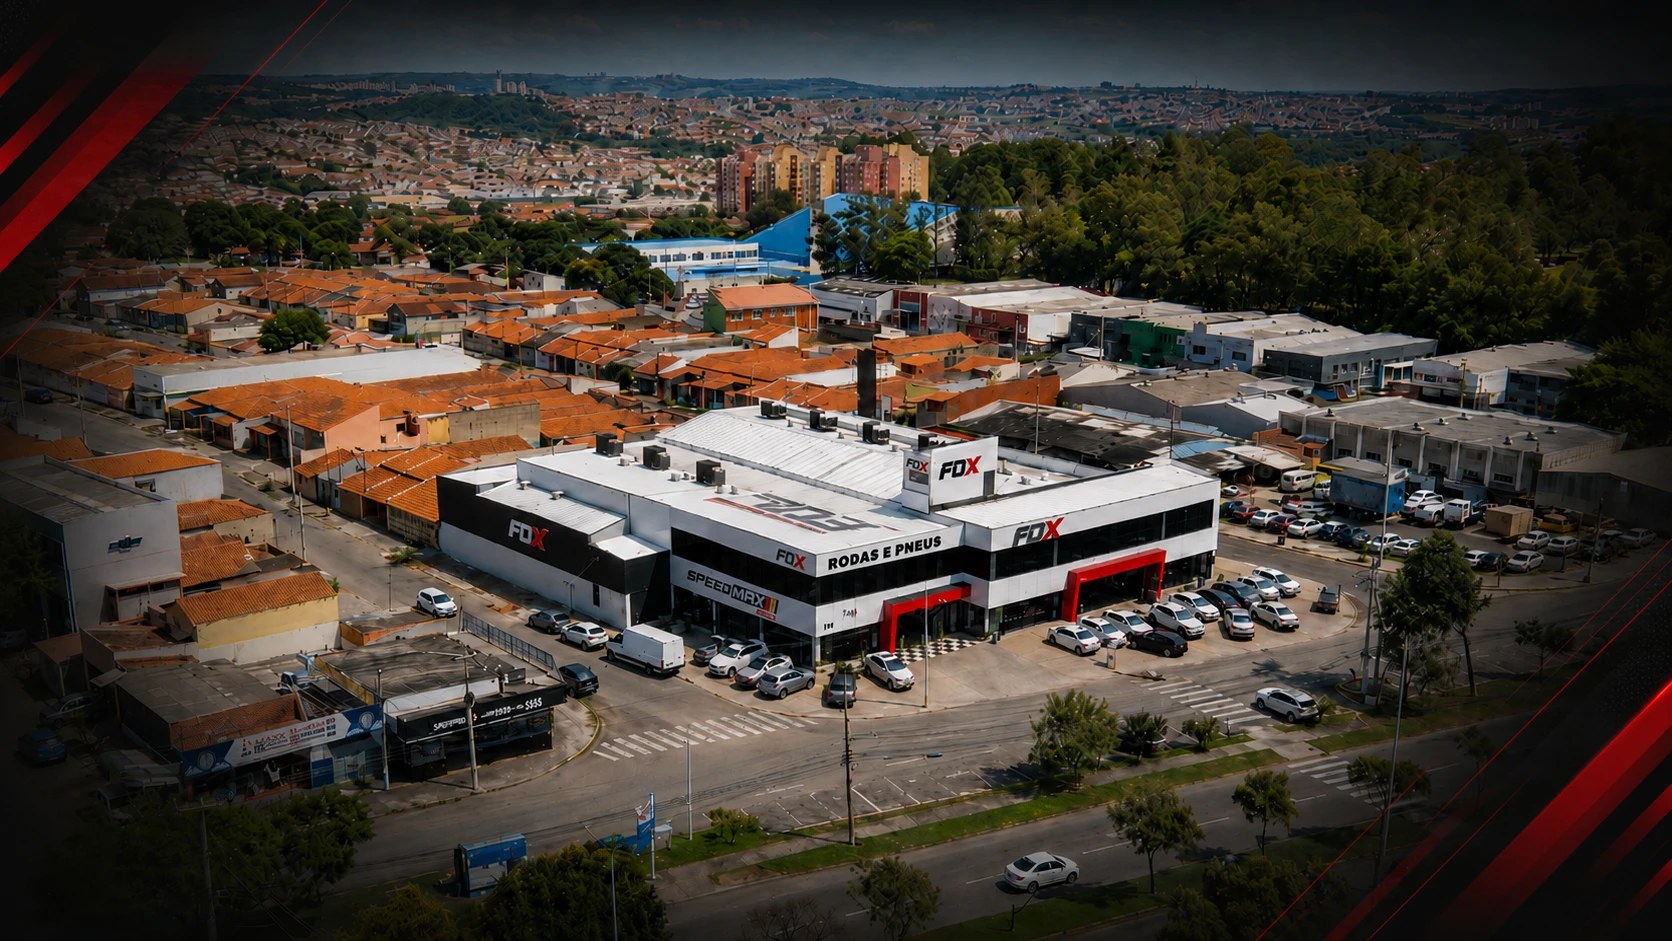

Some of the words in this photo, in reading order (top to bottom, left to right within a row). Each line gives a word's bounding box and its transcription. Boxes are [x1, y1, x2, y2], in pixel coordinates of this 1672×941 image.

[828, 549, 879, 570] RODAS
[883, 546, 892, 559] E
[895, 535, 942, 556] PNEUS
